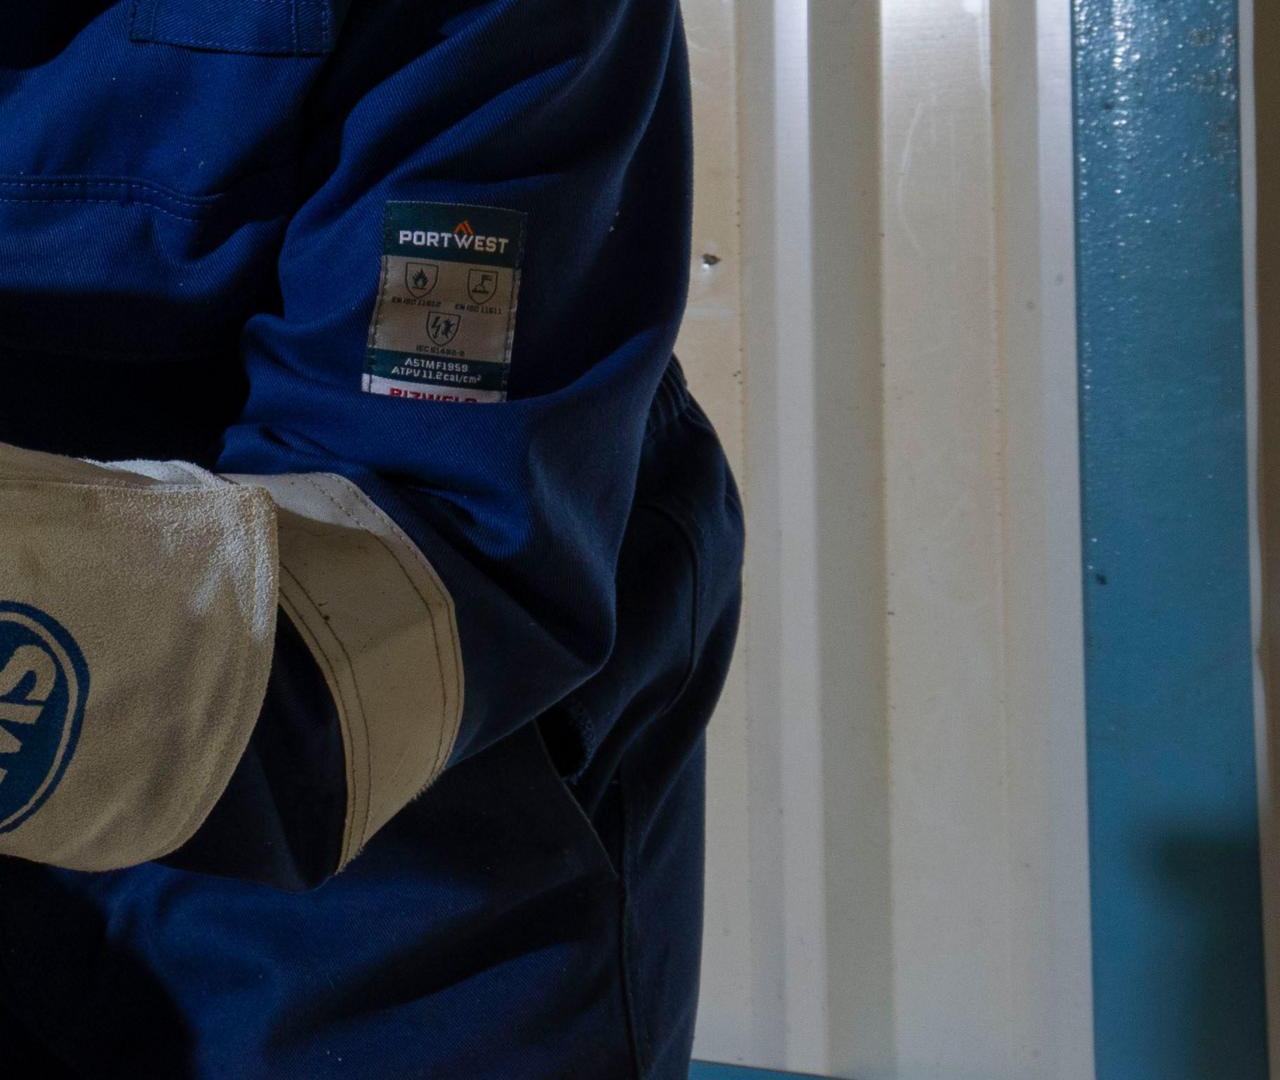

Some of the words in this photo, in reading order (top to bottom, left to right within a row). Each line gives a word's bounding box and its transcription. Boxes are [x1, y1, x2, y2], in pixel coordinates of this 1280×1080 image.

[398, 230, 509, 254] PORTWEST
[404, 357, 435, 370] ASTM
[391, 366, 421, 377] ATPV
